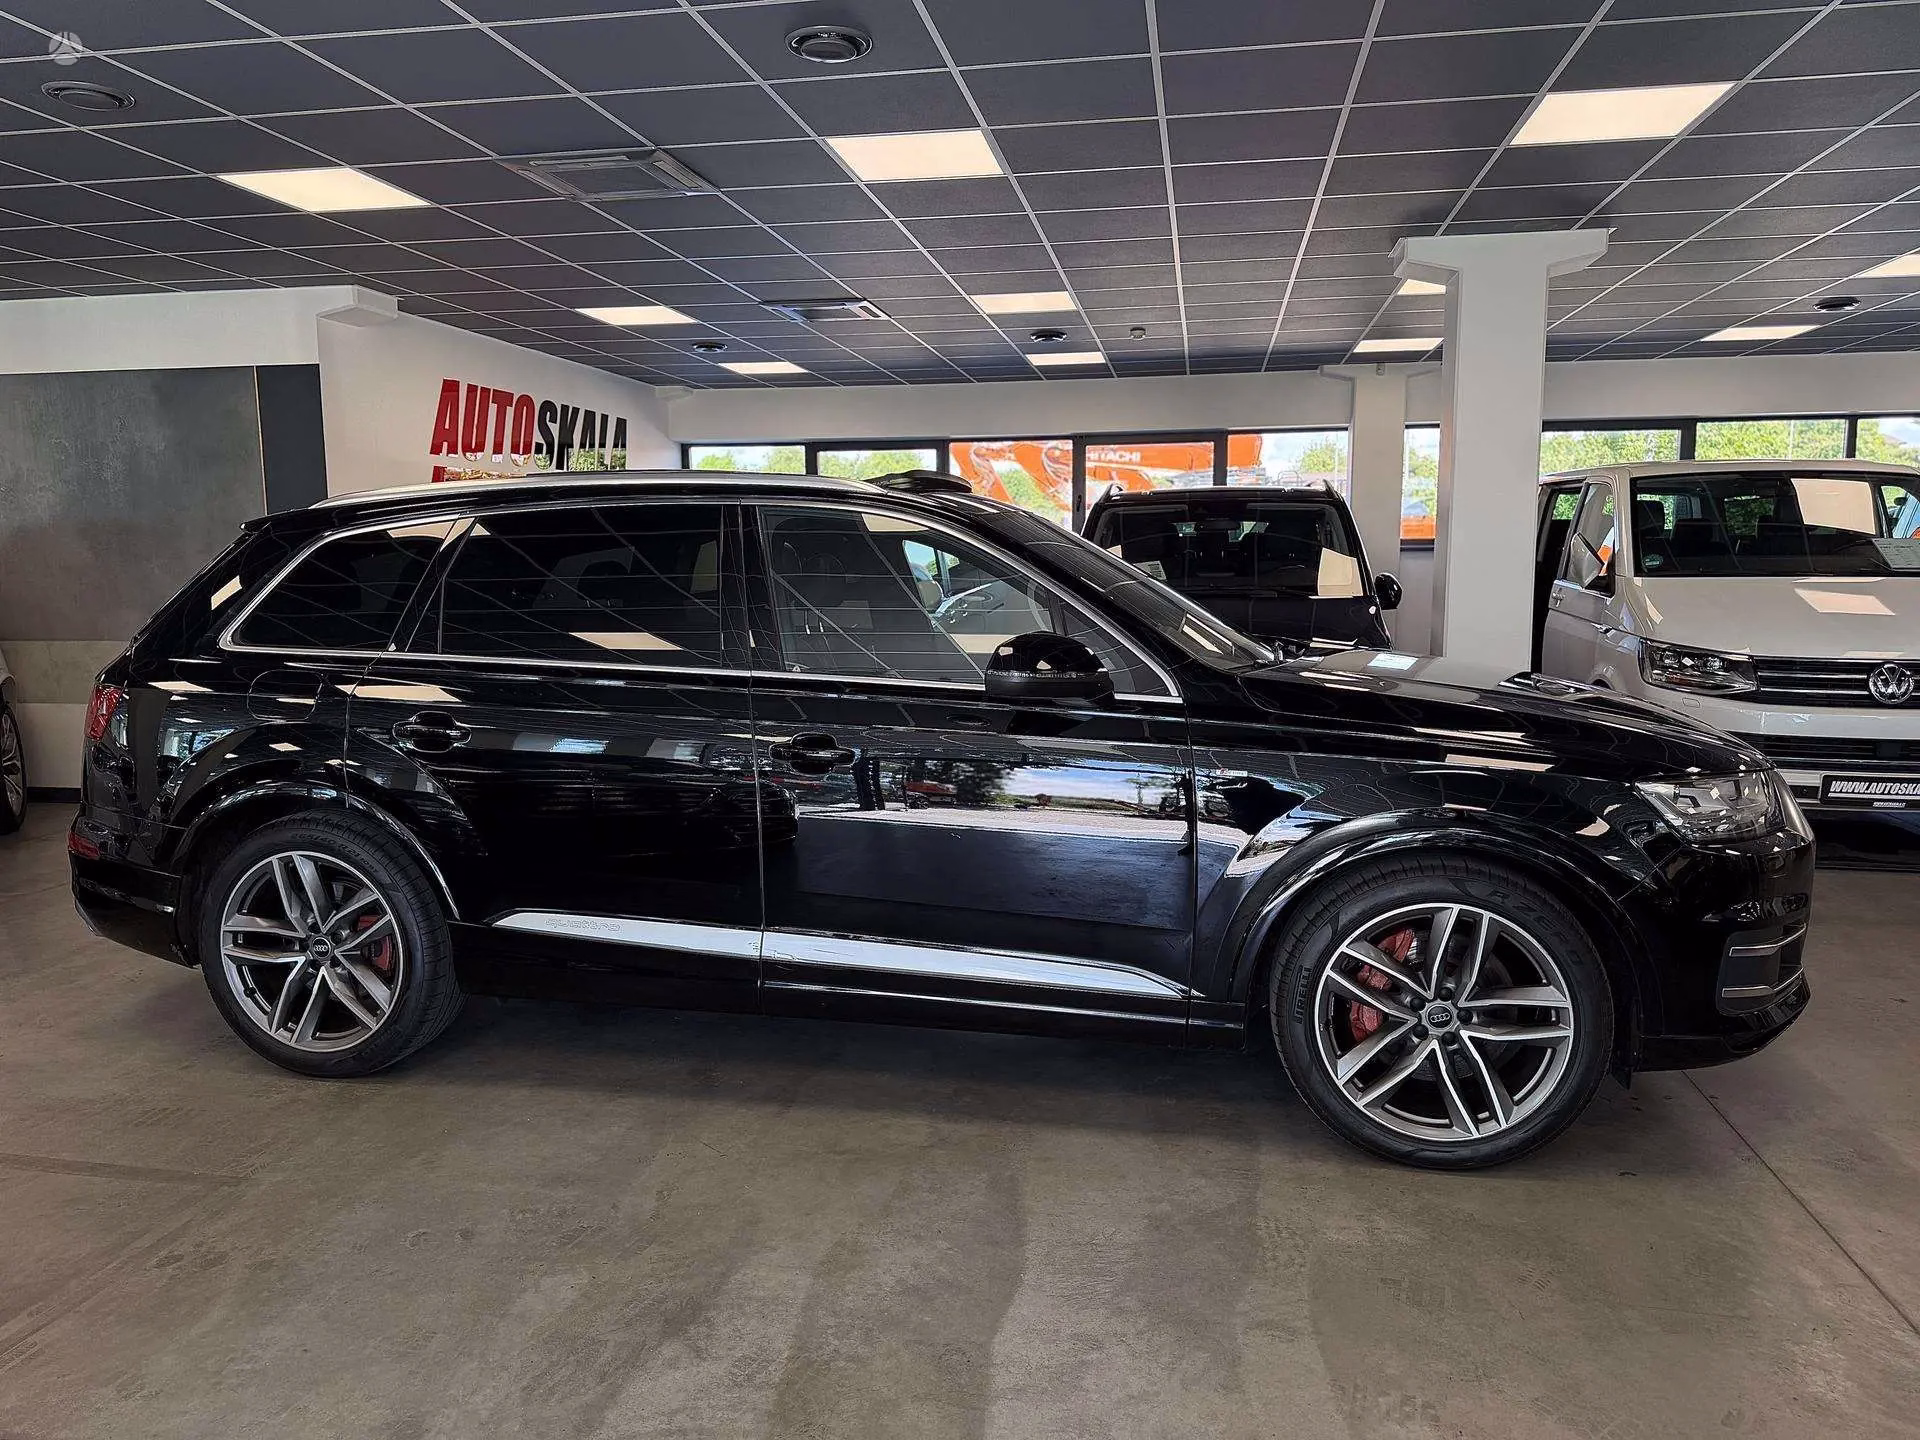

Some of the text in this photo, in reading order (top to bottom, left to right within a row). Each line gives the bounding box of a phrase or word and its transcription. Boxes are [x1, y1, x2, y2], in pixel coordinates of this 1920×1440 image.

[430, 377, 628, 470] AUTOSKALA
[1086, 451, 1141, 461] HITACHI
[546, 918, 621, 932] quattro
